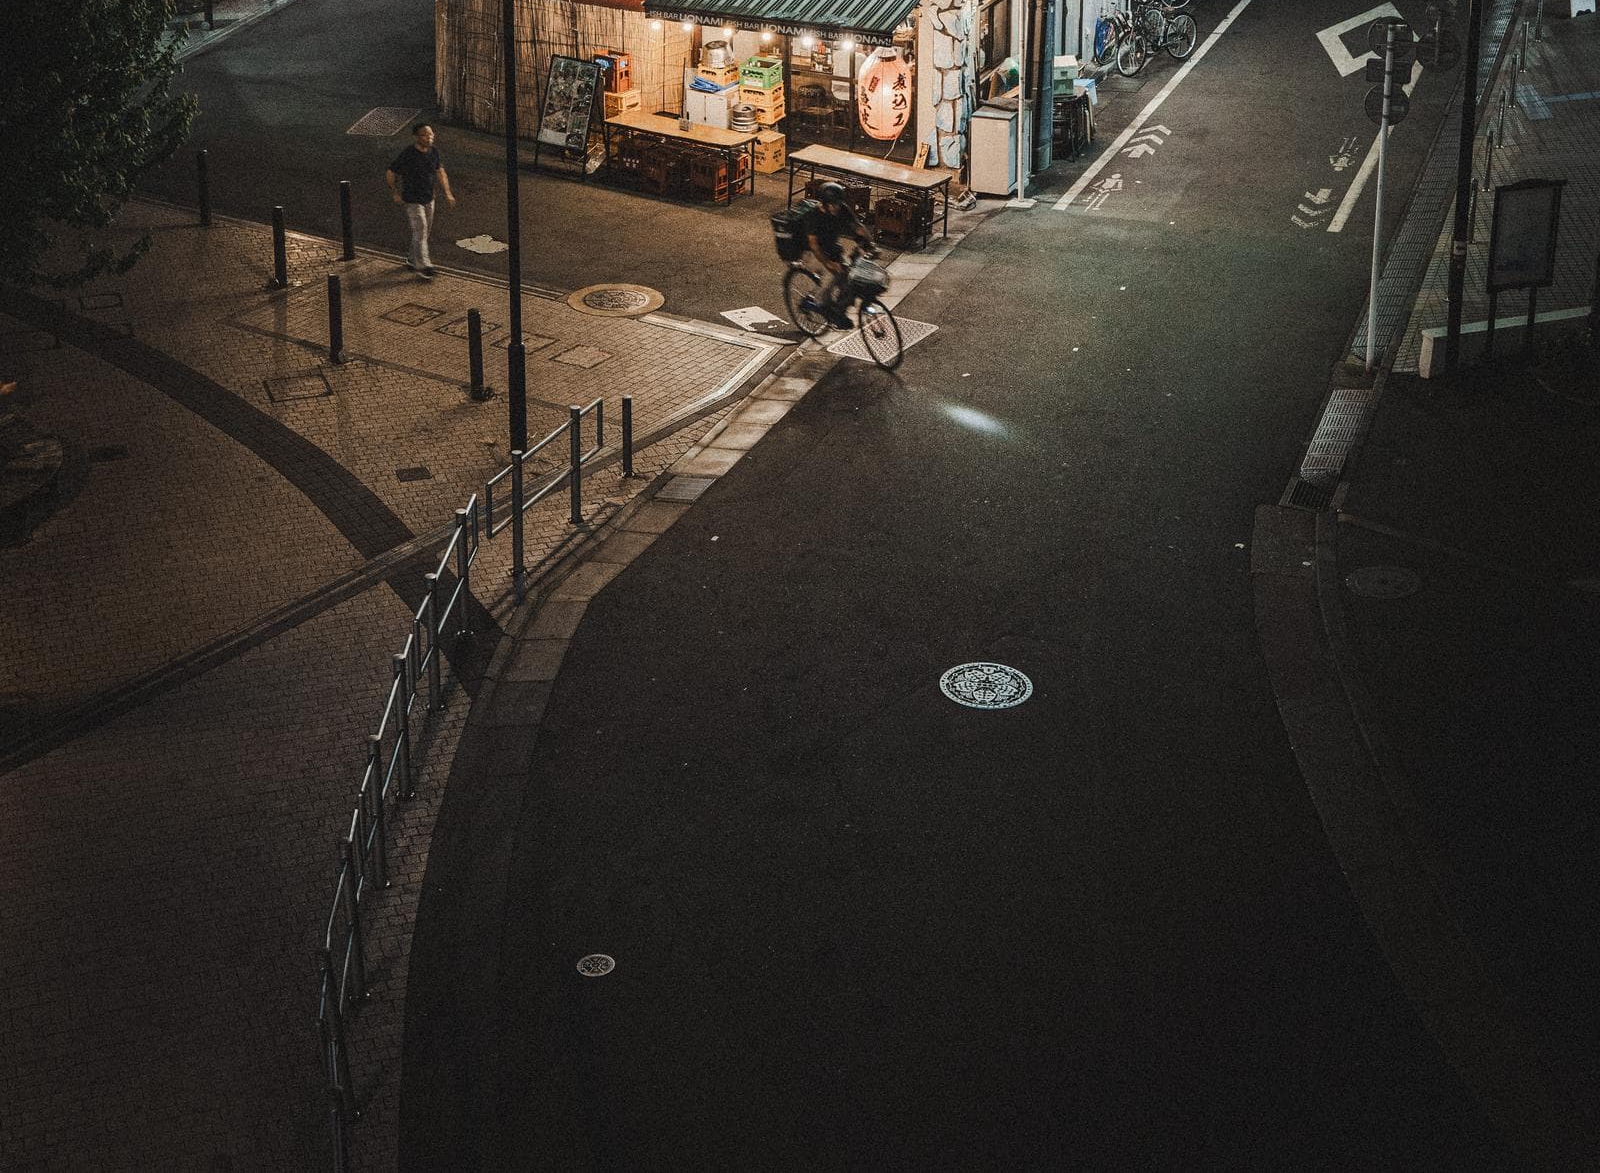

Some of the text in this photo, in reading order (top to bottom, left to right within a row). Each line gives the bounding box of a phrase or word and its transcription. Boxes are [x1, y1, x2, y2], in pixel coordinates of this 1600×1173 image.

[663, 12, 679, 21] BAR
[679, 13, 724, 26] UONAMI
[744, 22, 761, 30] BAR
[828, 31, 844, 40] BAR
